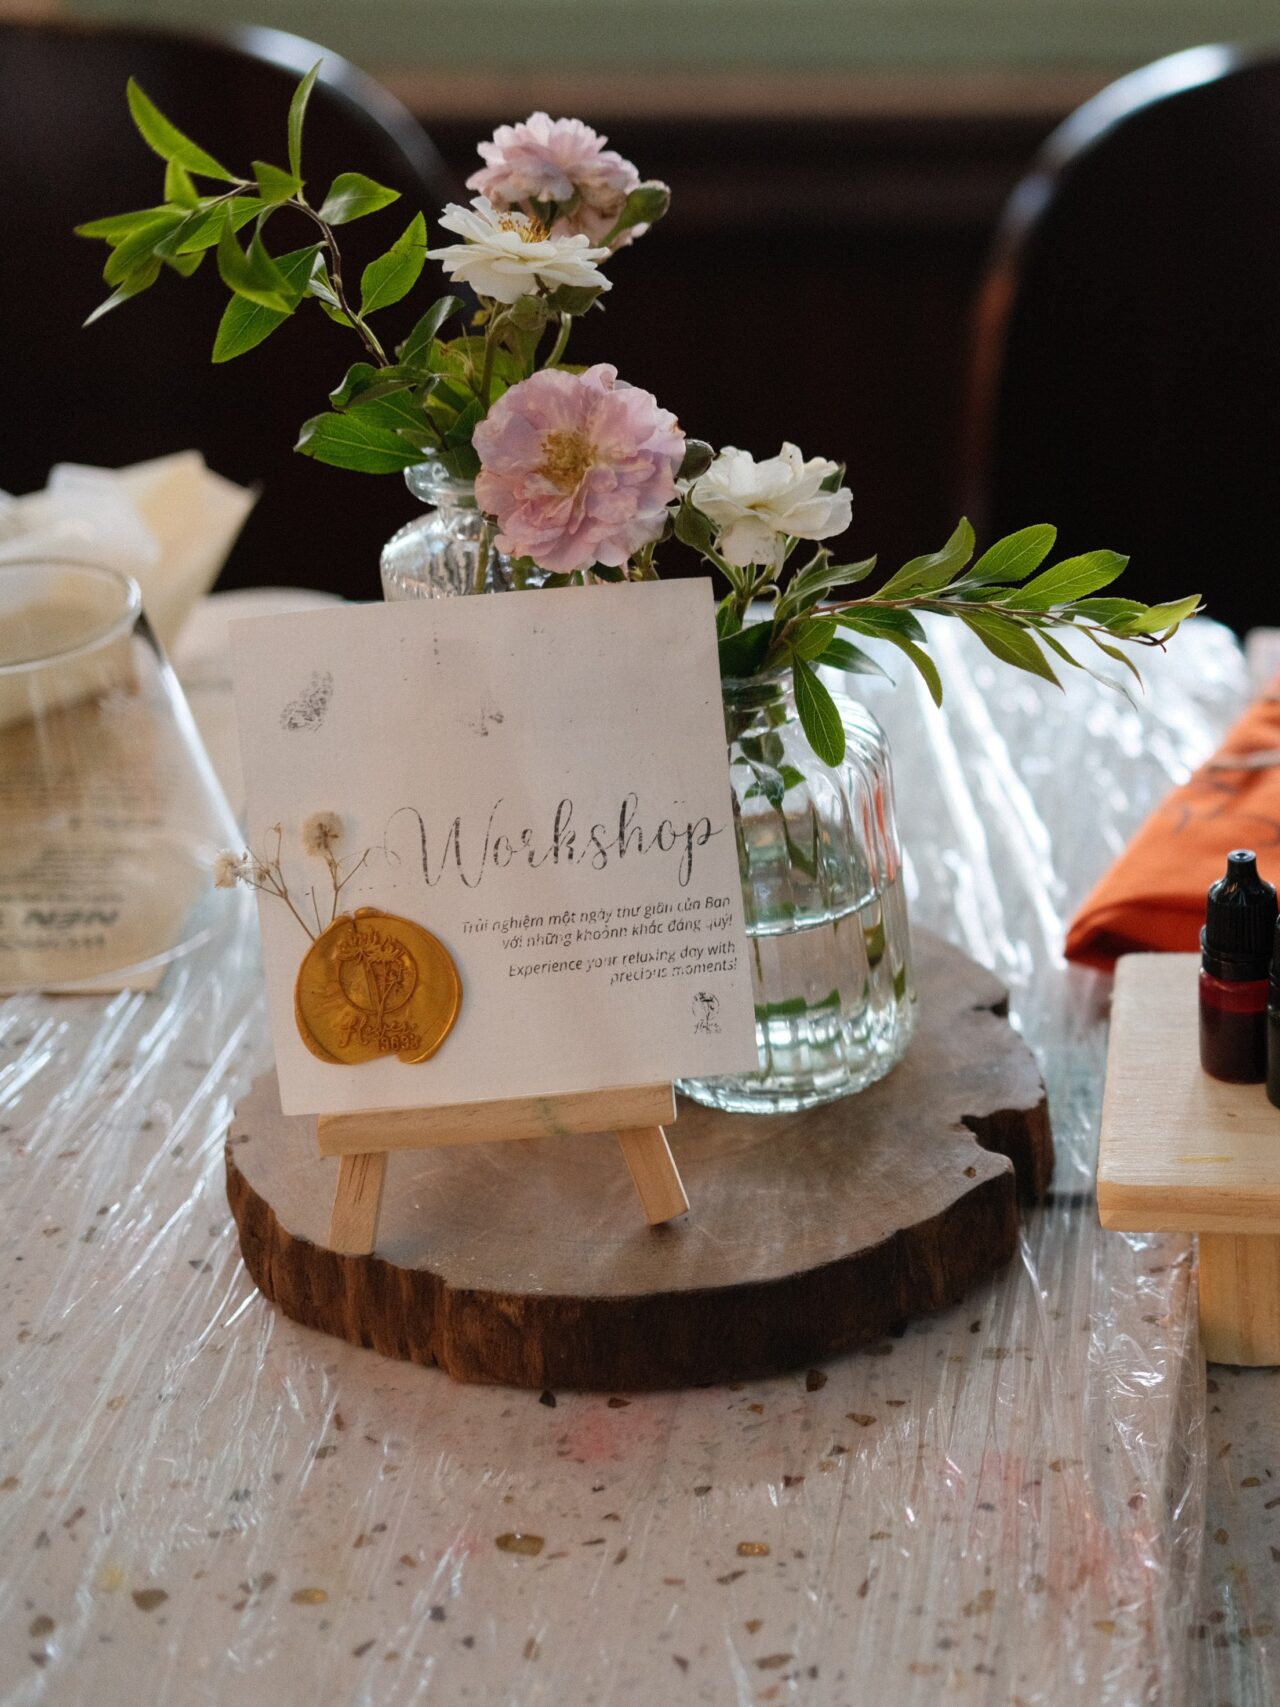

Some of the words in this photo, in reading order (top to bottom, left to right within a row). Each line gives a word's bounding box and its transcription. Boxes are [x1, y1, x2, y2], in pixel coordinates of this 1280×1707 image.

[383, 792, 727, 888] Workshop
[492, 914, 544, 933] nghiệm
[548, 910, 576, 926] một
[617, 905, 641, 918] thư
[509, 960, 583, 978] Experience
[680, 945, 704, 960] day
[708, 940, 736, 957] with
